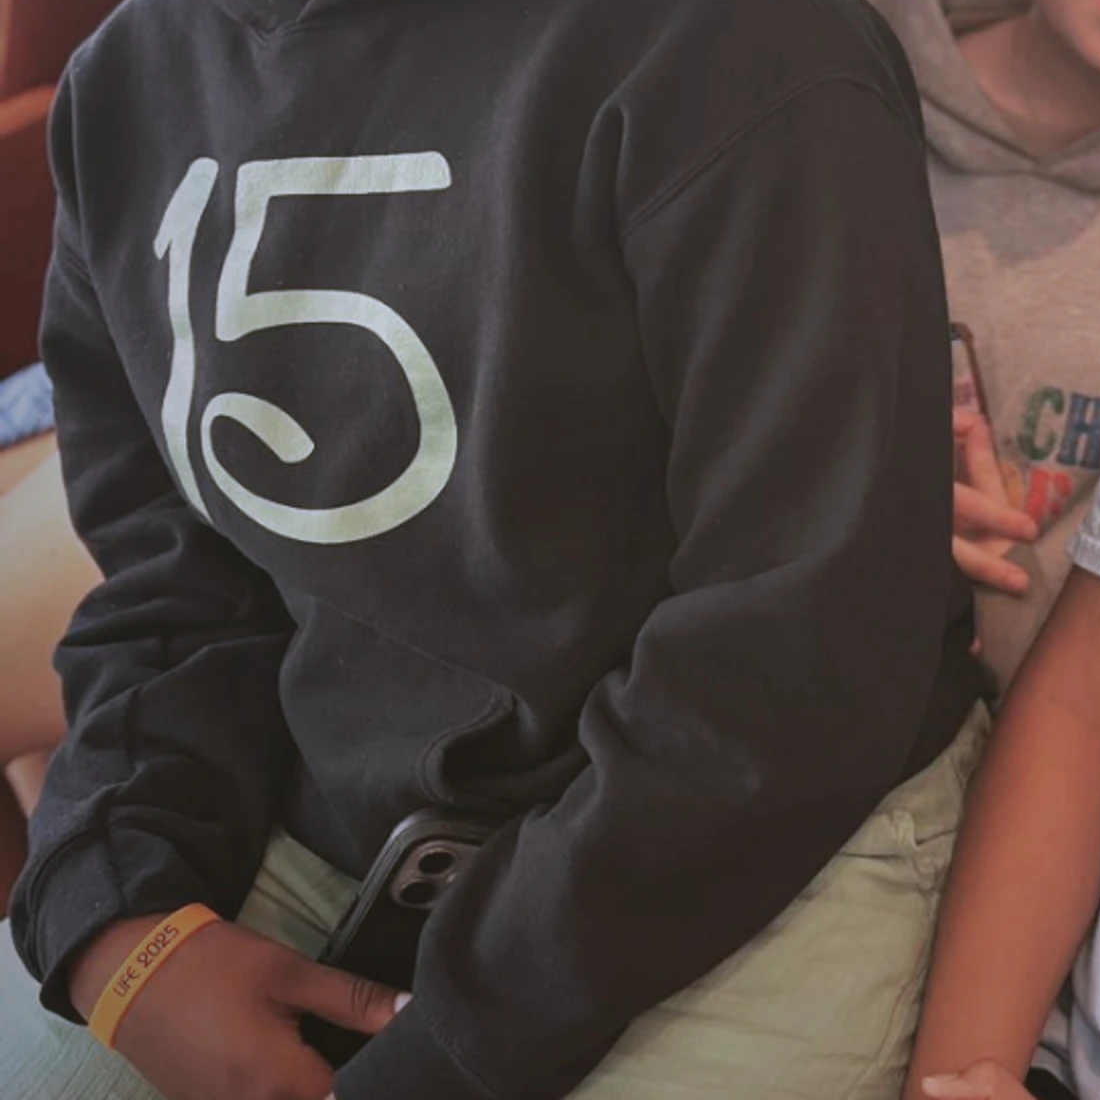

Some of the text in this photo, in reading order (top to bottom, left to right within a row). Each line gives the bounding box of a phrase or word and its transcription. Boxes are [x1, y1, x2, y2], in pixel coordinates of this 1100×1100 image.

[154, 151, 457, 544] 15
[113, 924, 181, 998] LIFE 2025
